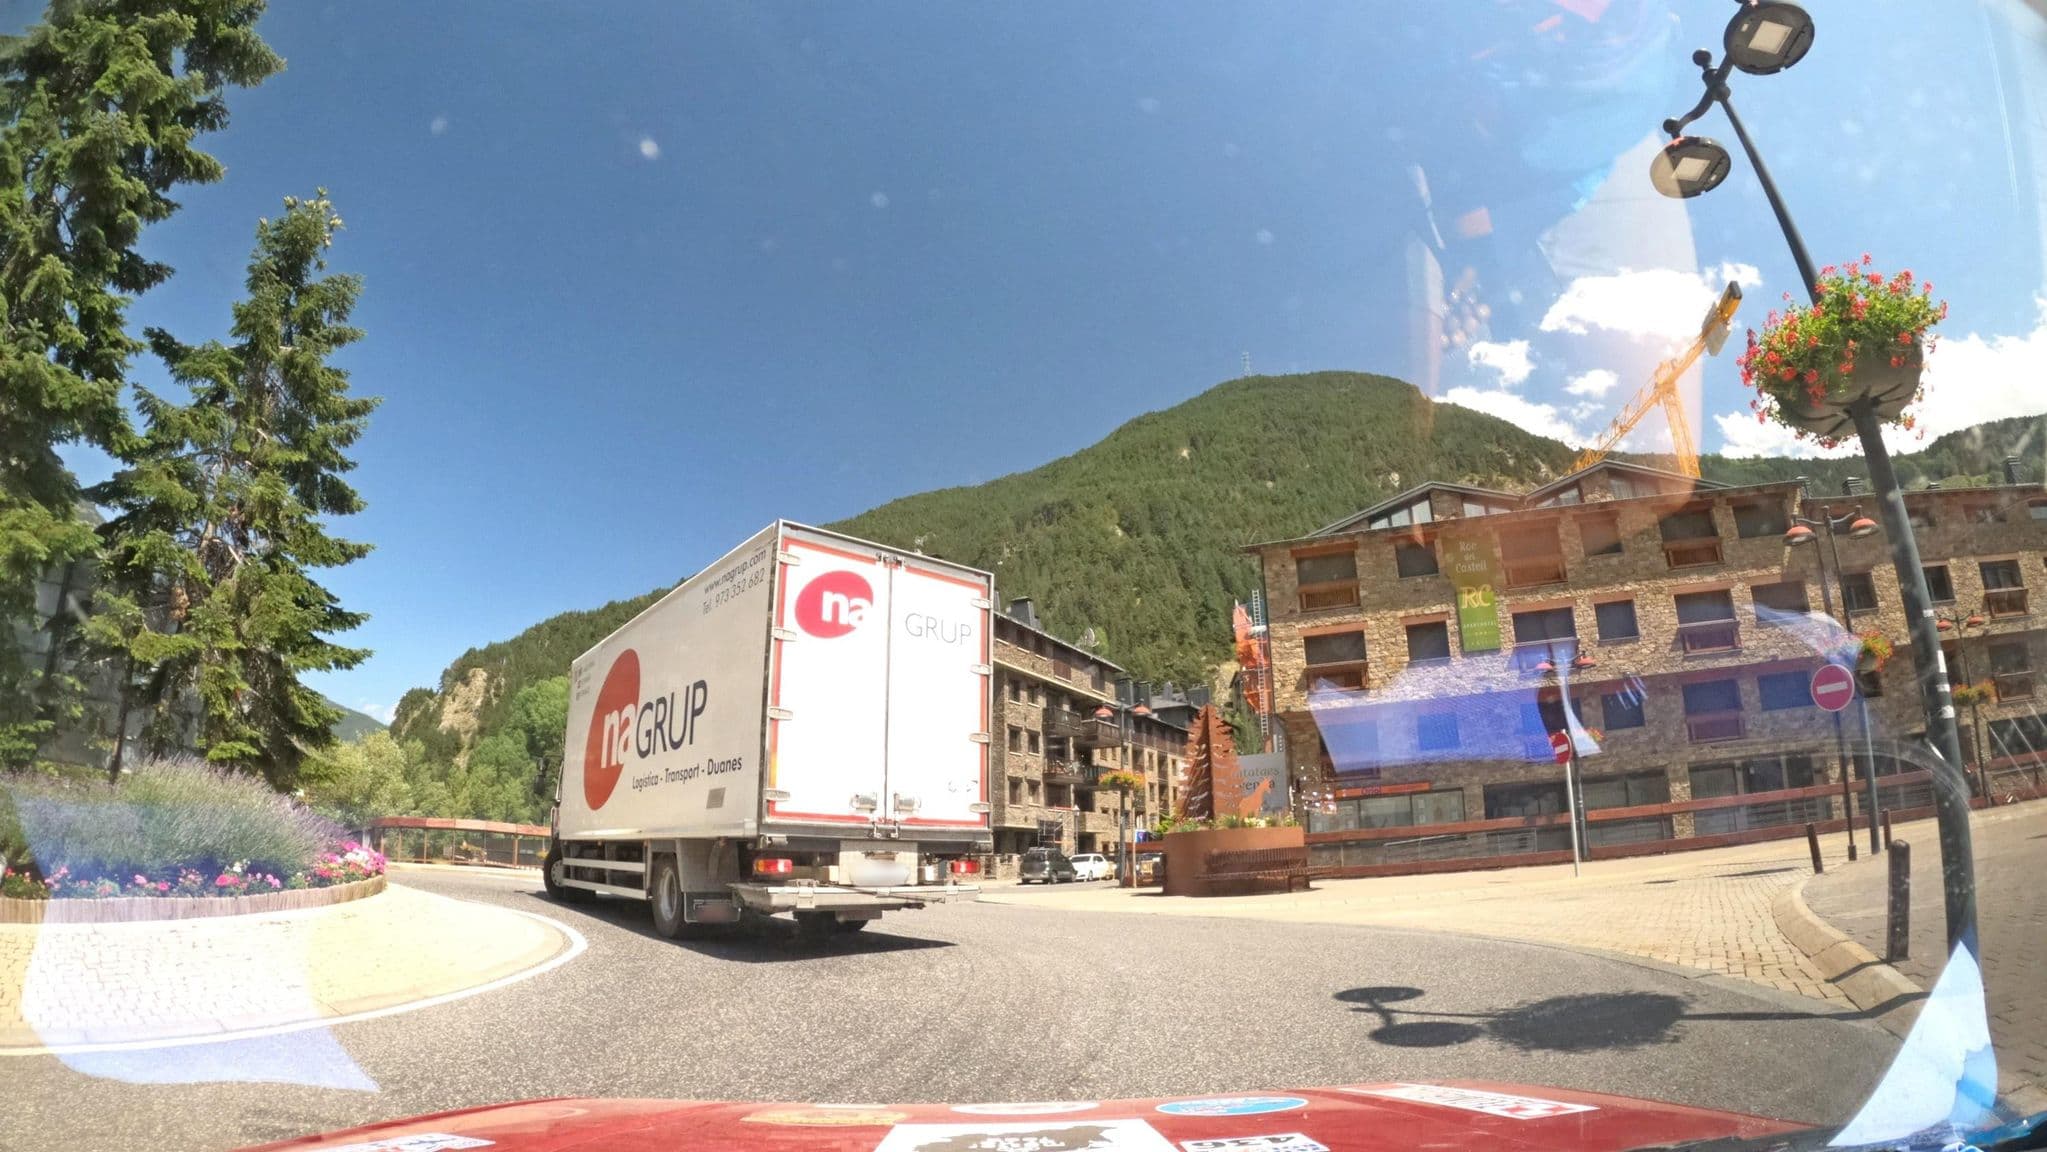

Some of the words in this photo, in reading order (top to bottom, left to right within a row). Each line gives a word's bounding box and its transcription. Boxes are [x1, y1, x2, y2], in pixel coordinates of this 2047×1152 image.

[1459, 541, 1477, 552] Roc
[704, 550, 766, 595] www.nagrup.com
[748, 567, 765, 589] 682
[1456, 560, 1488, 573] Castell
[1460, 584, 1492, 609] RC
[821, 590, 873, 626] na
[905, 613, 972, 645] GRUP
[601, 703, 636, 769] na
[636, 680, 708, 759] GRUP
[665, 763, 700, 784] Transport
[707, 757, 743, 776] Duanes
